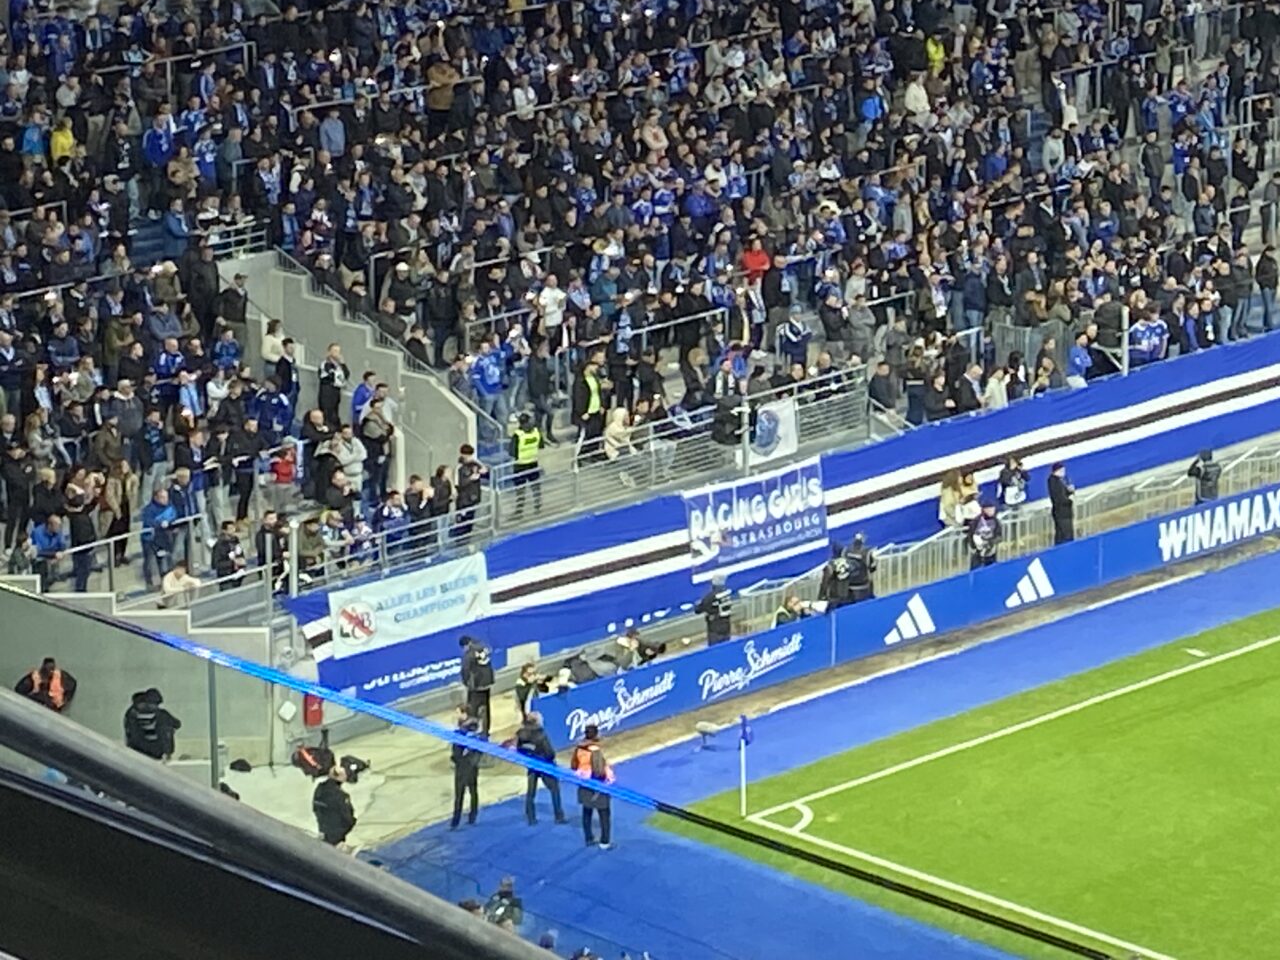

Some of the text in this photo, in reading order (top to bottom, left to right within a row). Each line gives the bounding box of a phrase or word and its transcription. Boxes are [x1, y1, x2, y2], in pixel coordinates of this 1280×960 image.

[732, 512, 820, 548] STRASBOURG
[698, 632, 804, 701] Pierre Schmidt
[613, 670, 677, 714] Schmidt
